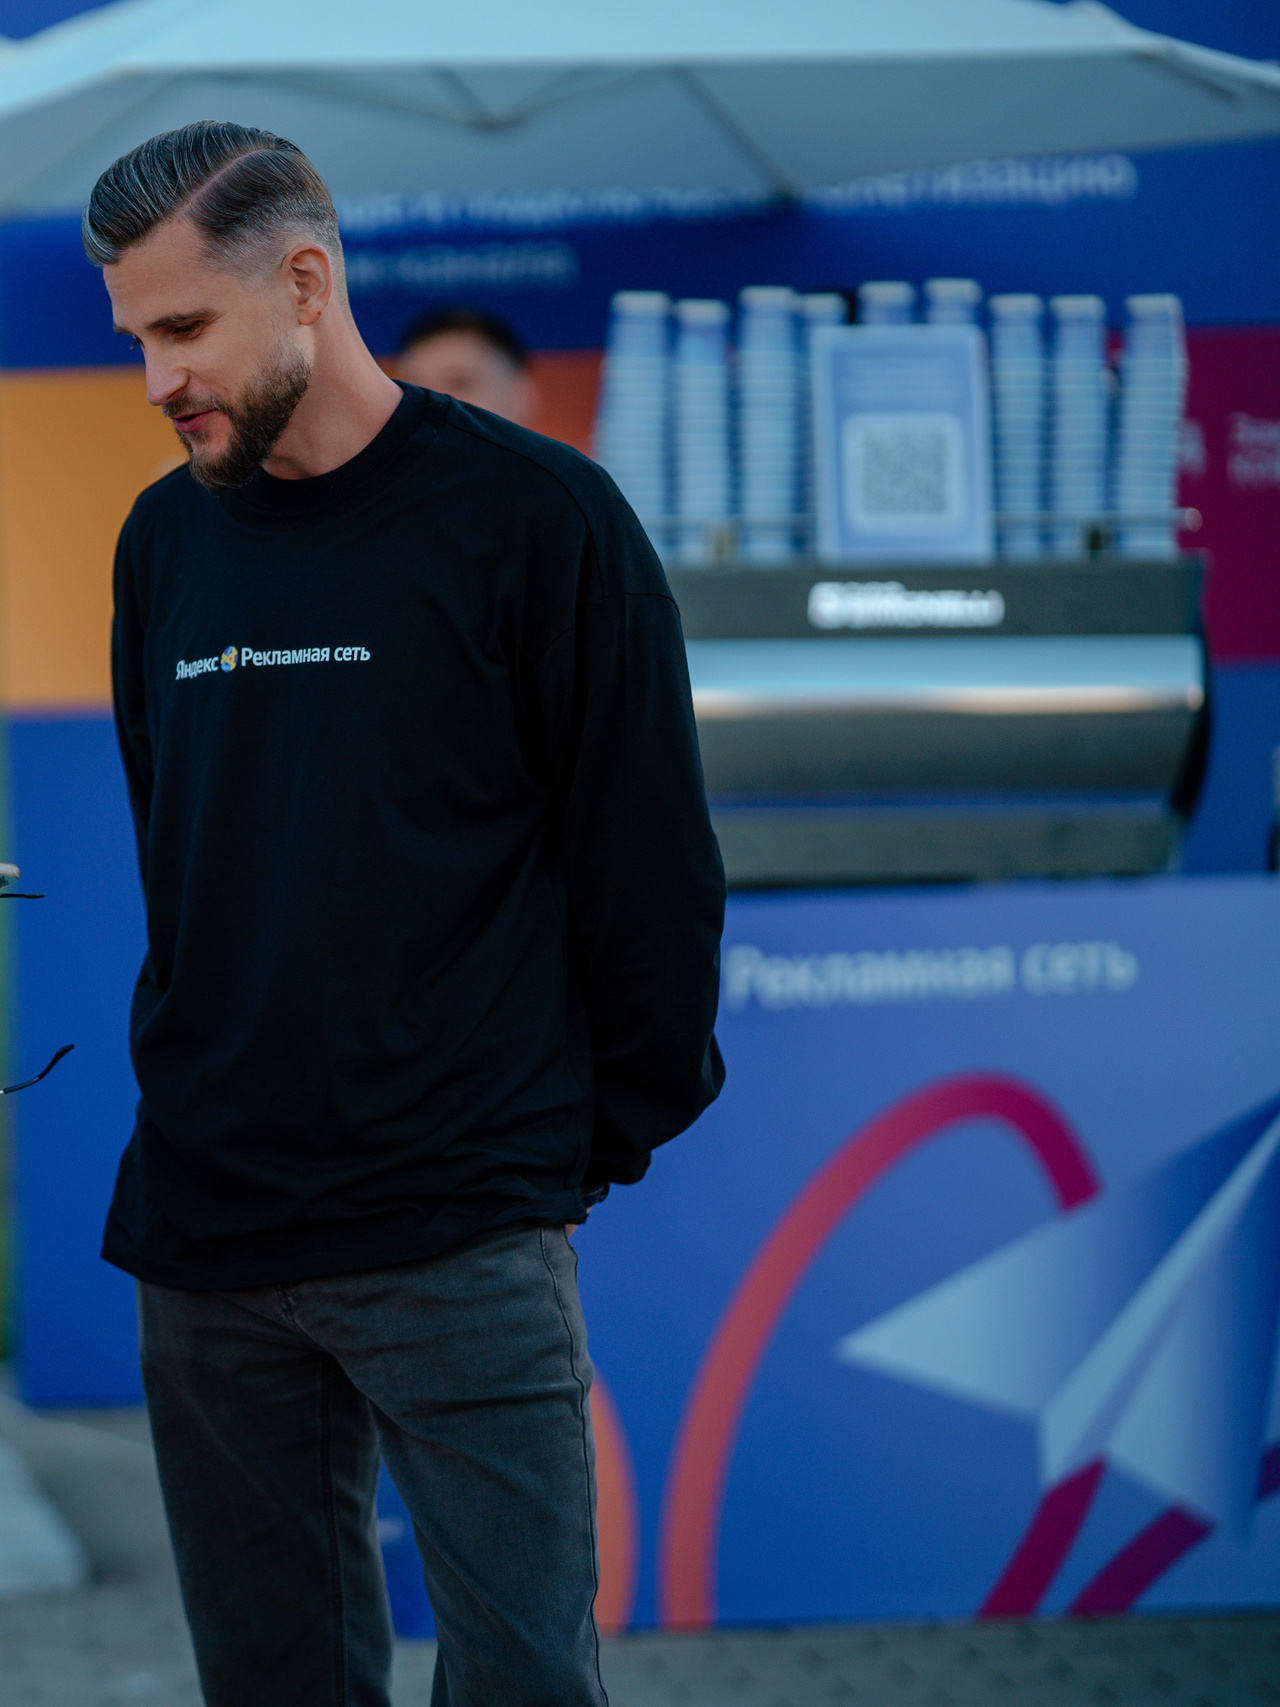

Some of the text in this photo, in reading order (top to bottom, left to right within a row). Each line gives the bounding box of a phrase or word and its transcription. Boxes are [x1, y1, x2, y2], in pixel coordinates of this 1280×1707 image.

[175, 646, 371, 681] Яндекс Рекламная сеть
[1022, 942, 1136, 997] сеть
